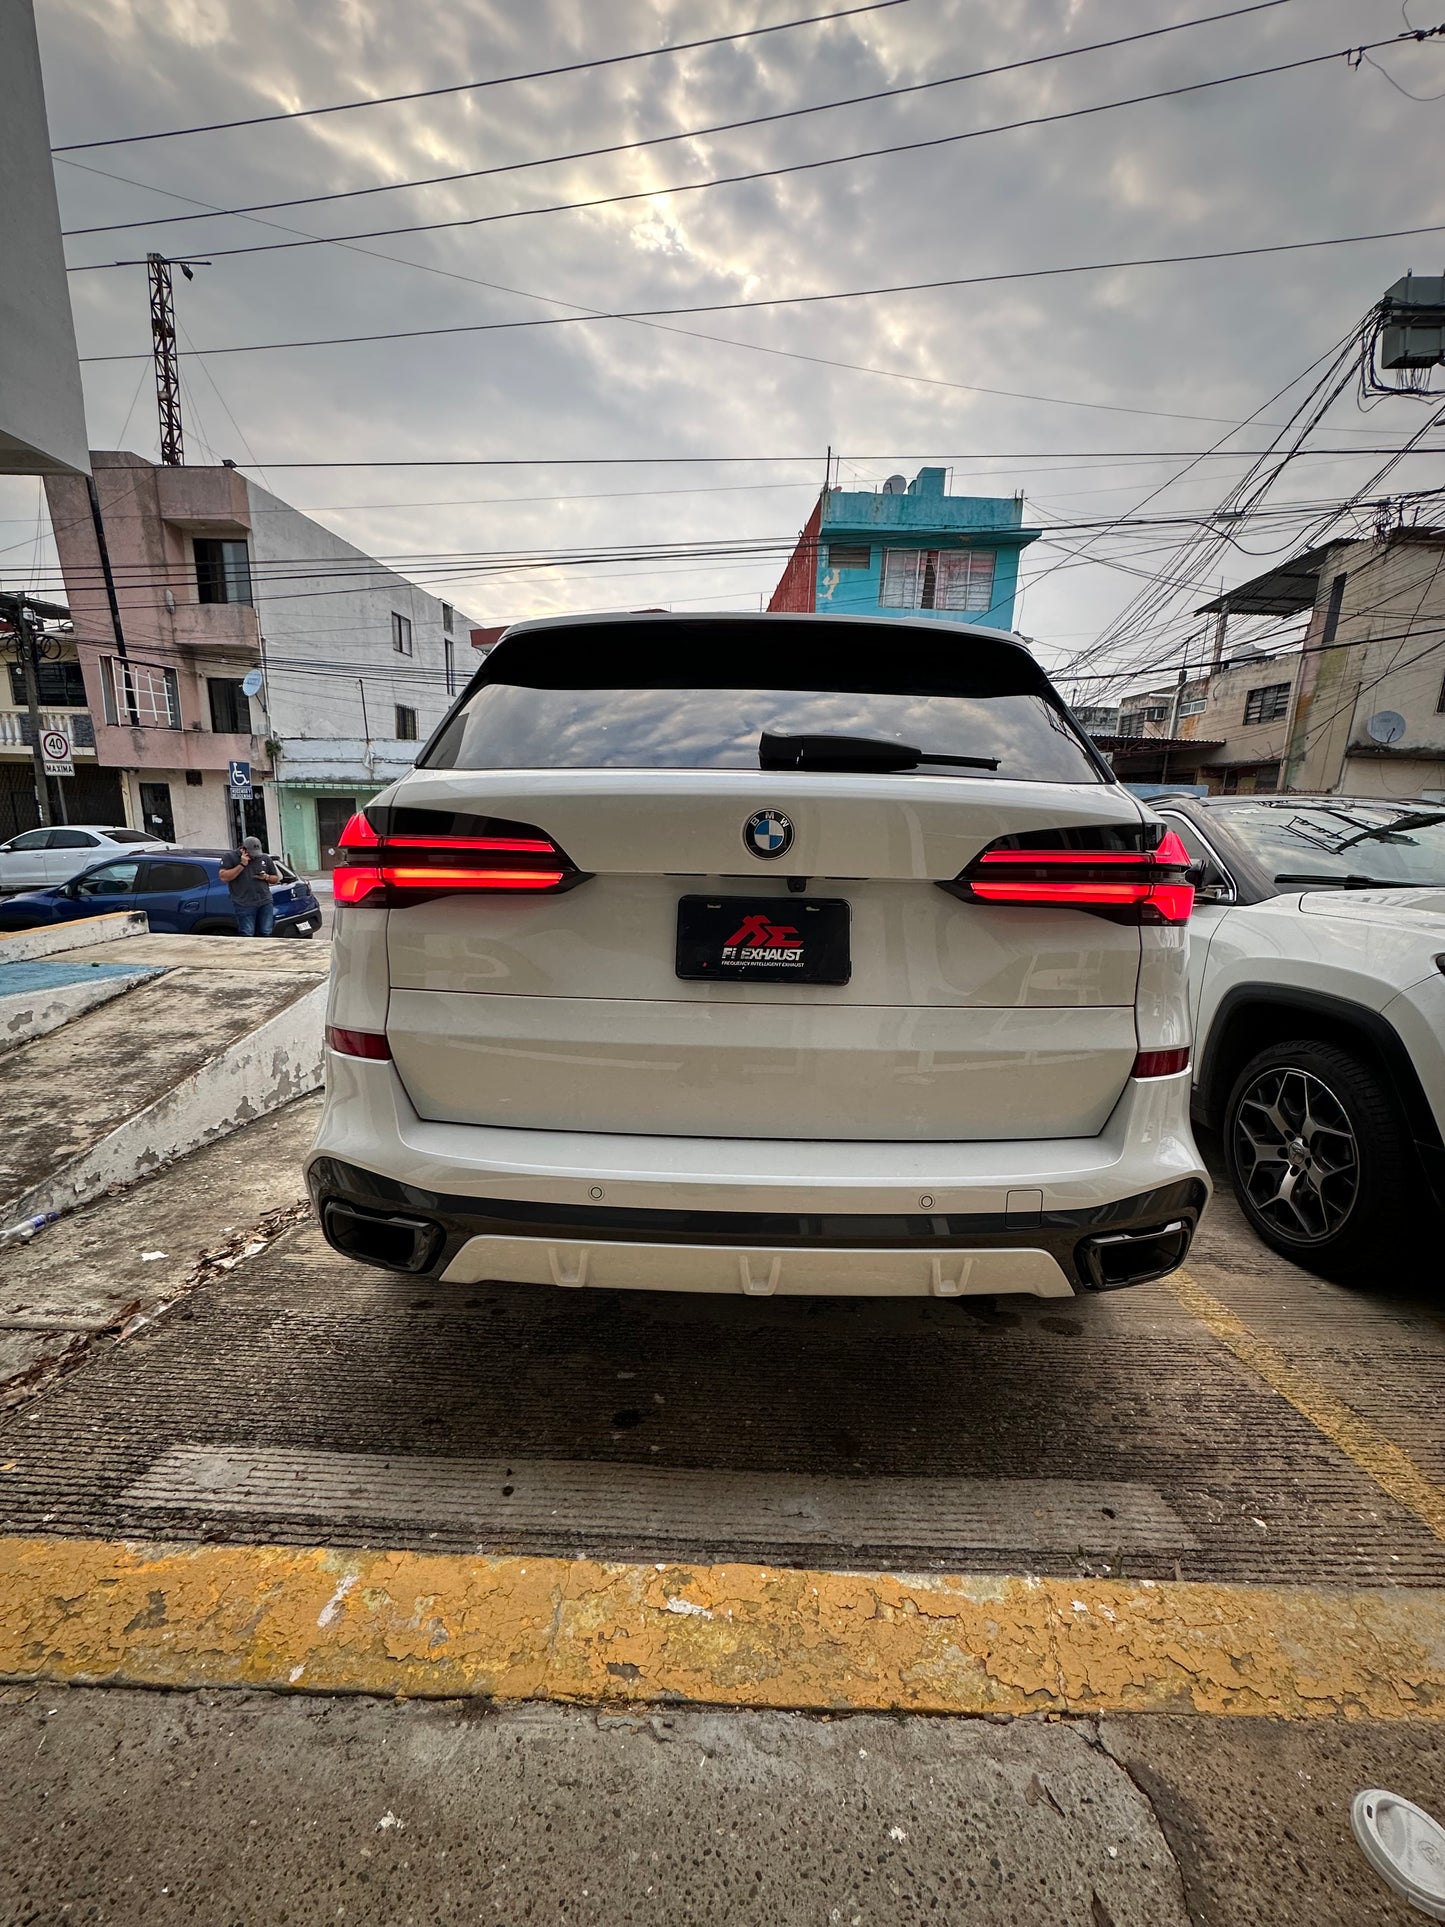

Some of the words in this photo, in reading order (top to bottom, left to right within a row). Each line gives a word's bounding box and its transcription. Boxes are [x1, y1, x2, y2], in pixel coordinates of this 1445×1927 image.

[49, 738, 63, 750] 40
[46, 764, 73, 773] MAXIMA
[750, 811, 790, 828] BMW
[740, 948, 804, 961] EXHAUST
